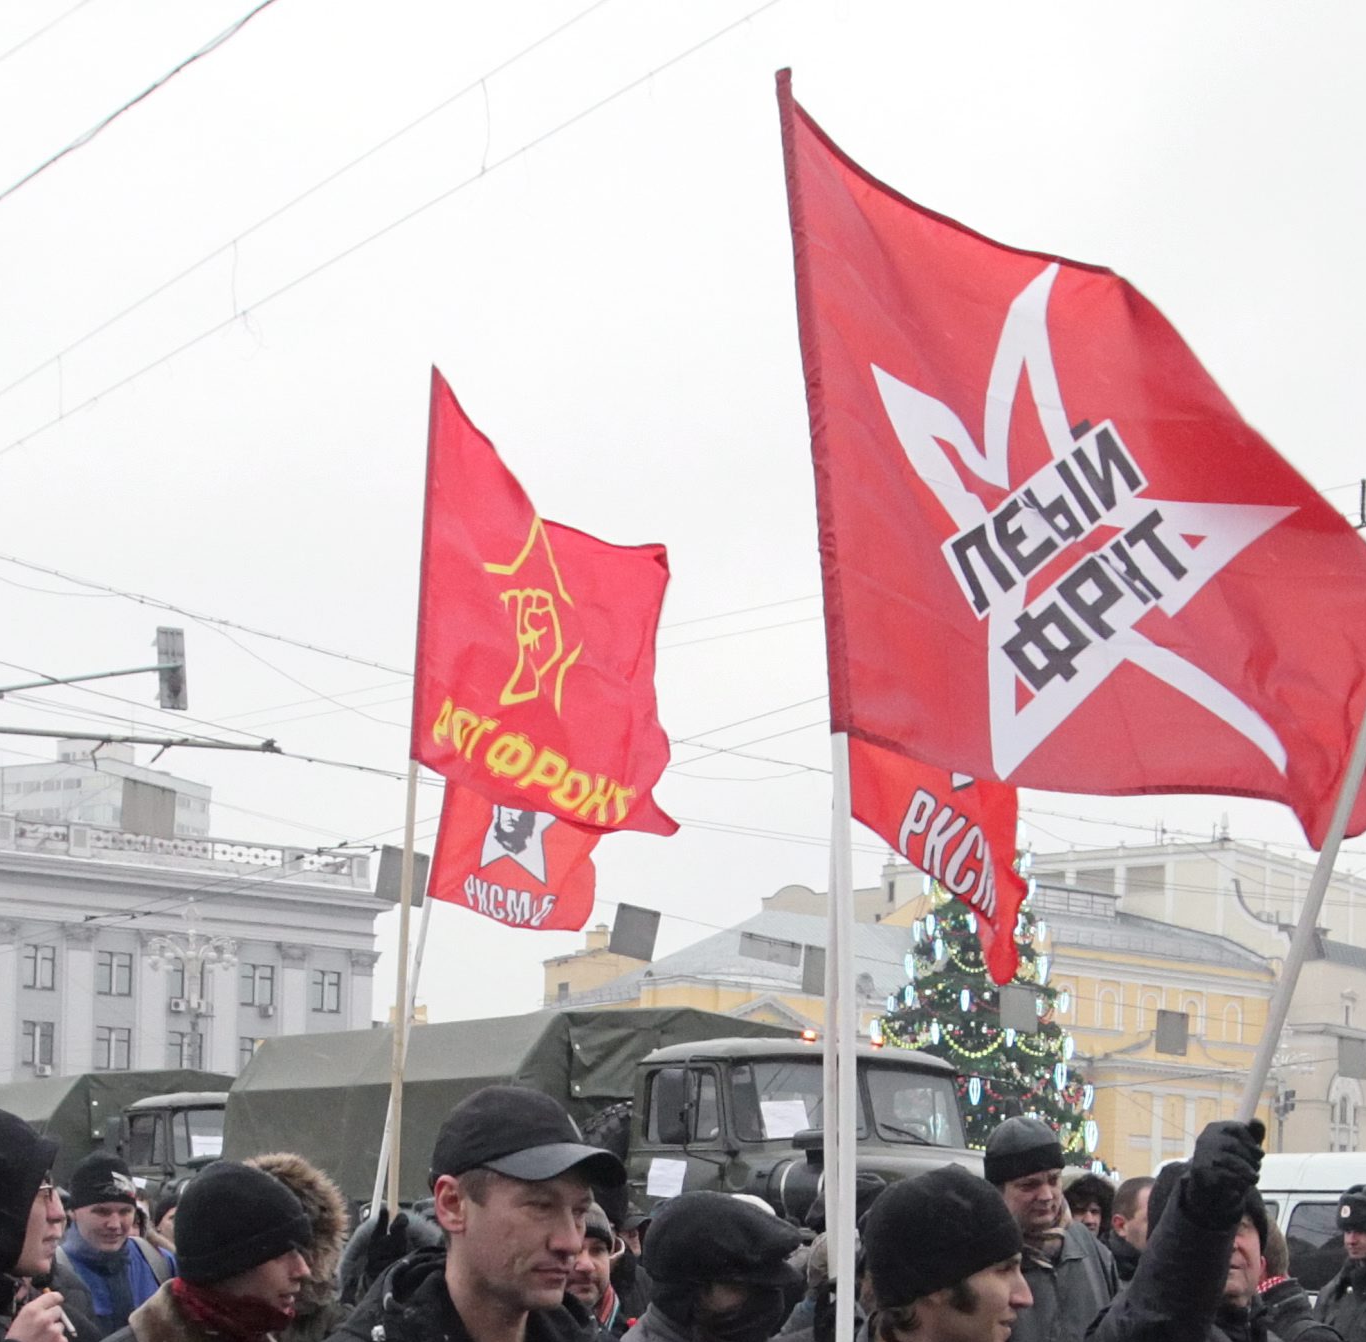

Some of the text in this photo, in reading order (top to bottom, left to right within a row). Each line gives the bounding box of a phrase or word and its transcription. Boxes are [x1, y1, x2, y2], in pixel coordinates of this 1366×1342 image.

[951, 419, 1142, 615] ЛЕЫЙ
[1001, 508, 1188, 692] ФРНТ
[484, 732, 636, 825] ФРОНТ
